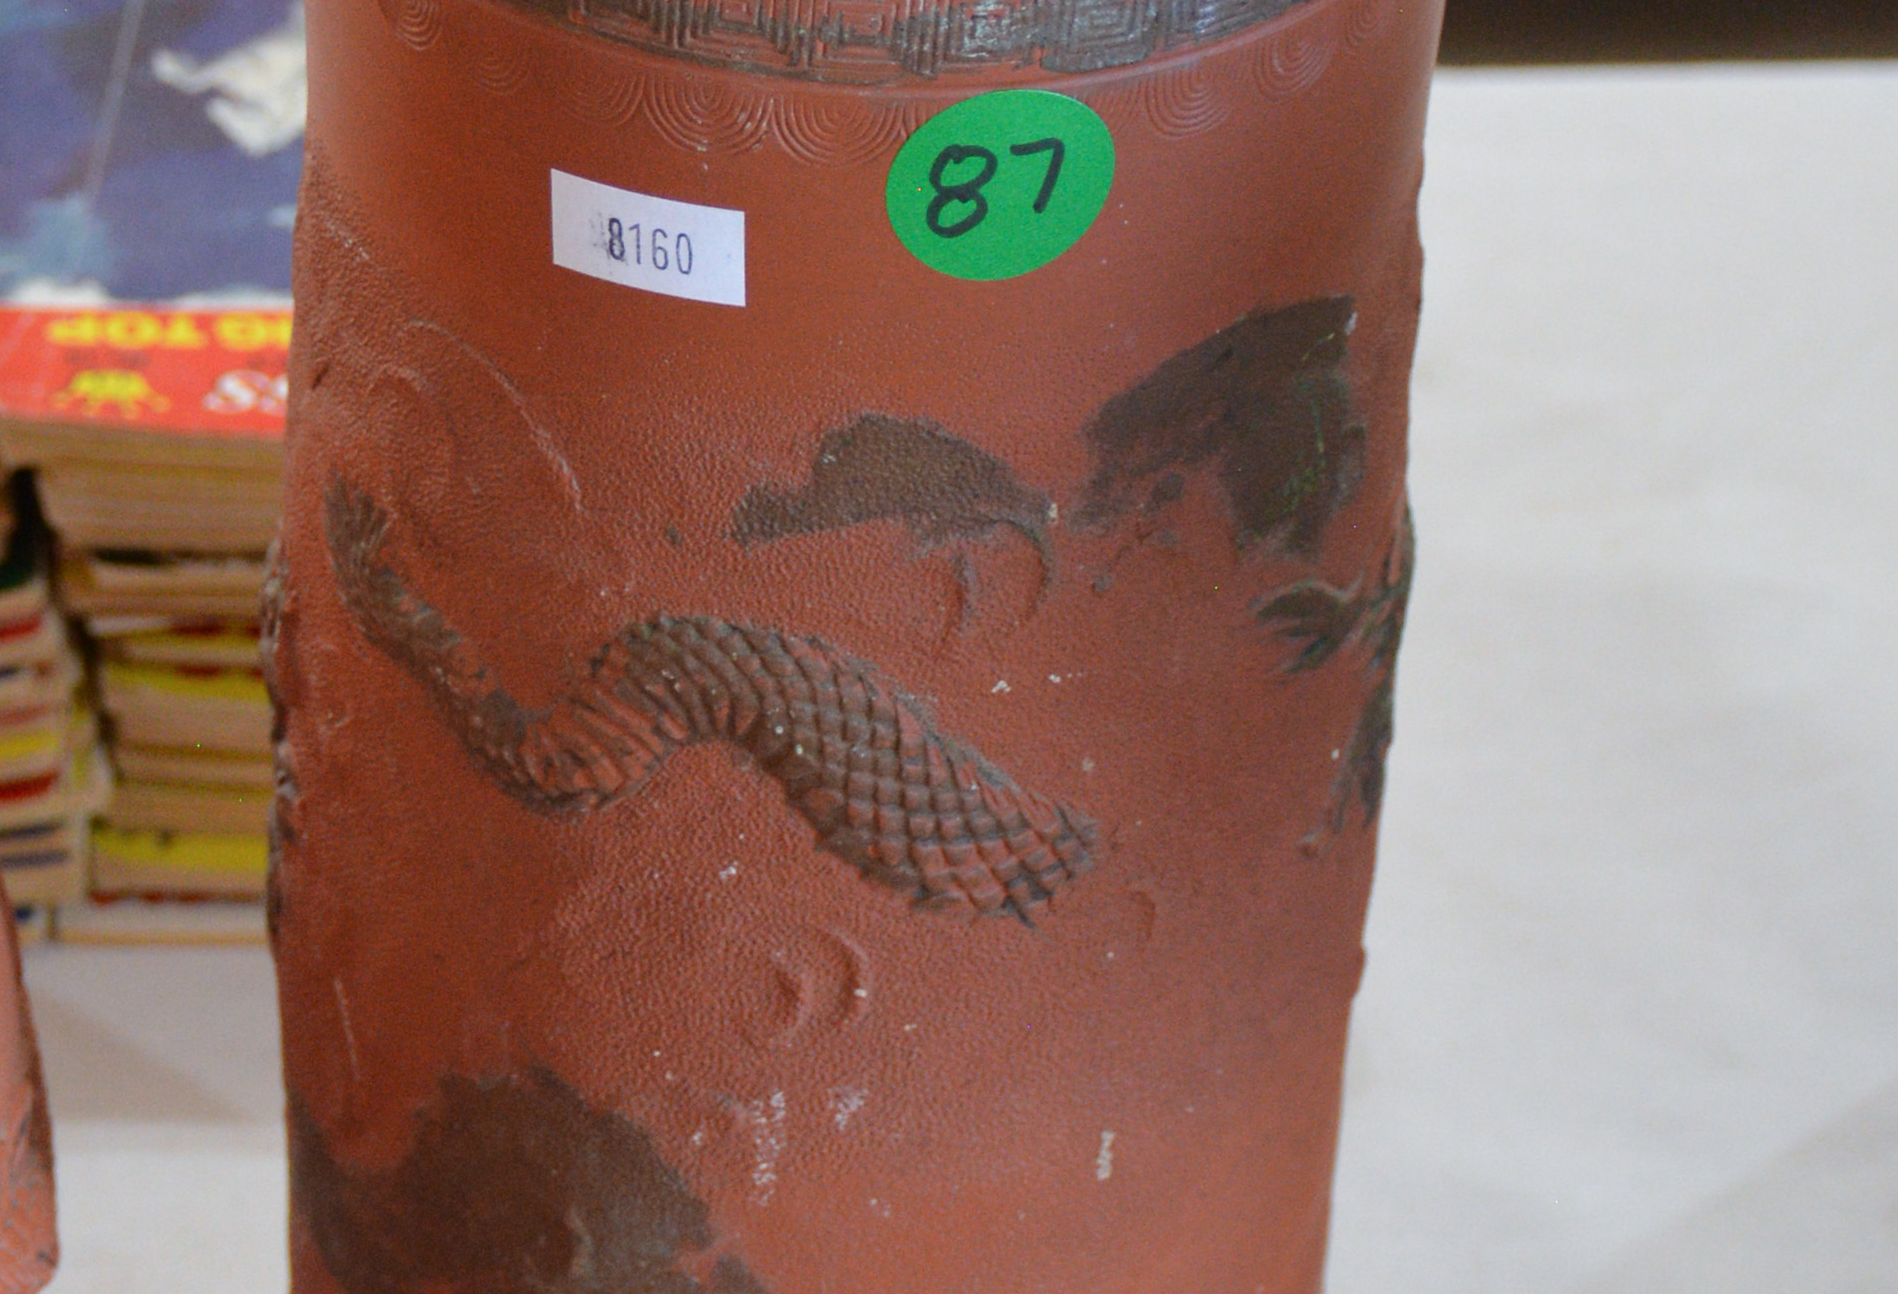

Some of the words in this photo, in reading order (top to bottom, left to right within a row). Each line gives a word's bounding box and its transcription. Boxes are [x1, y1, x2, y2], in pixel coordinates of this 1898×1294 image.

[925, 136, 1067, 239] 87
[605, 216, 695, 277] 8160
[45, 311, 207, 350] TOP
